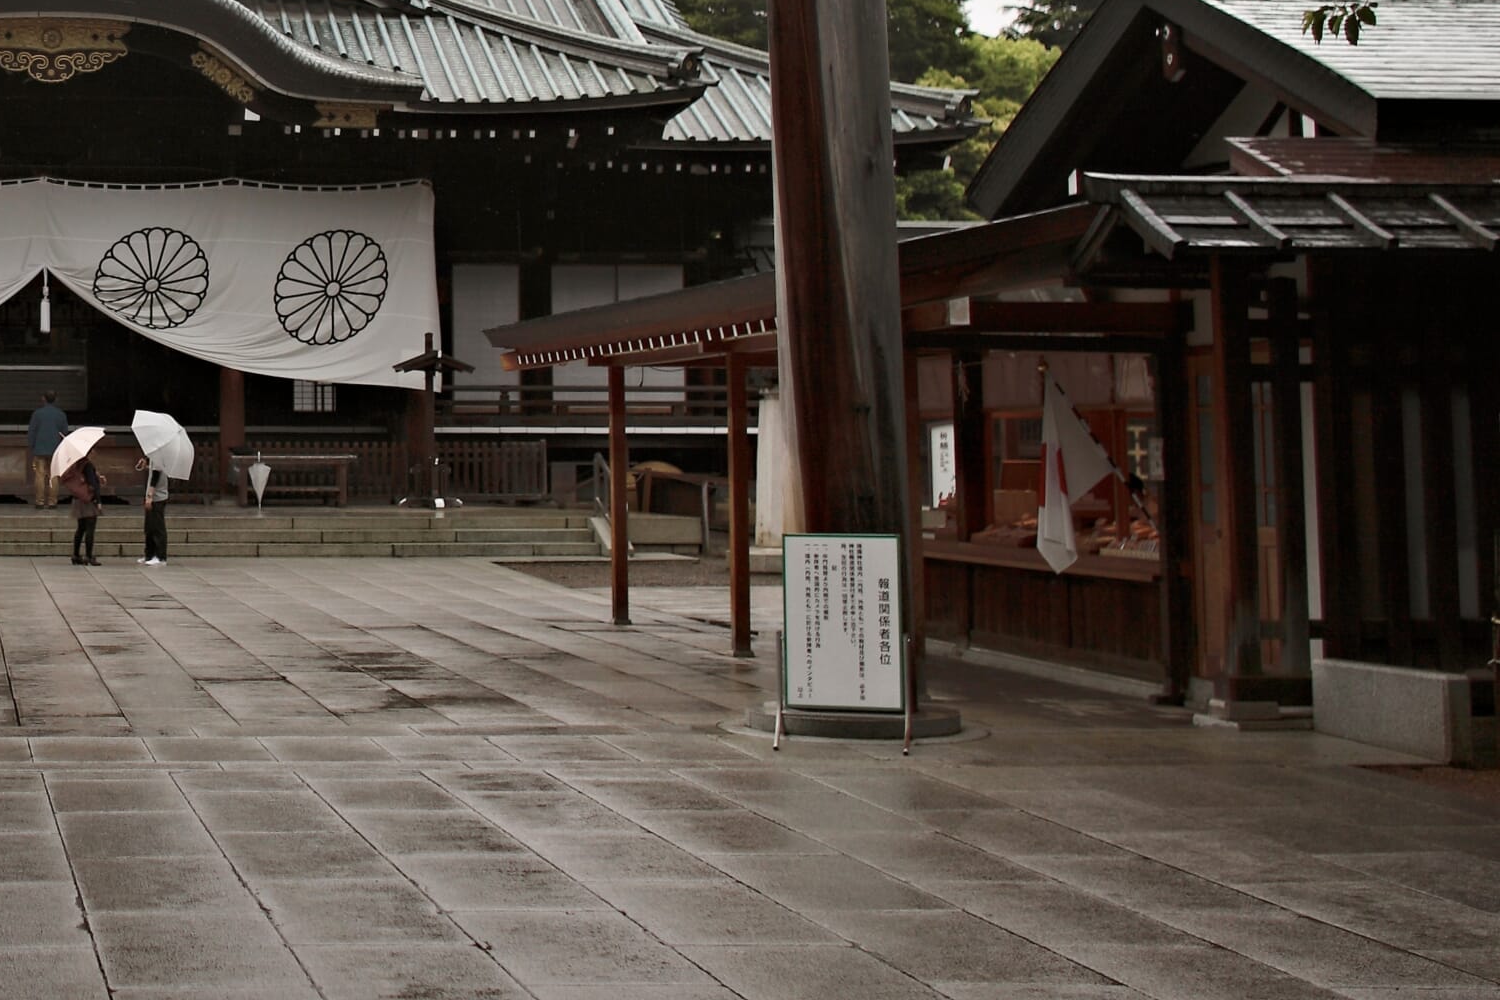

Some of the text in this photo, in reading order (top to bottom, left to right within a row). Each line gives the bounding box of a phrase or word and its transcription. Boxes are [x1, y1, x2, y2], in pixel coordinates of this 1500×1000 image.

[878, 578, 891, 665] 報道関係者各位
